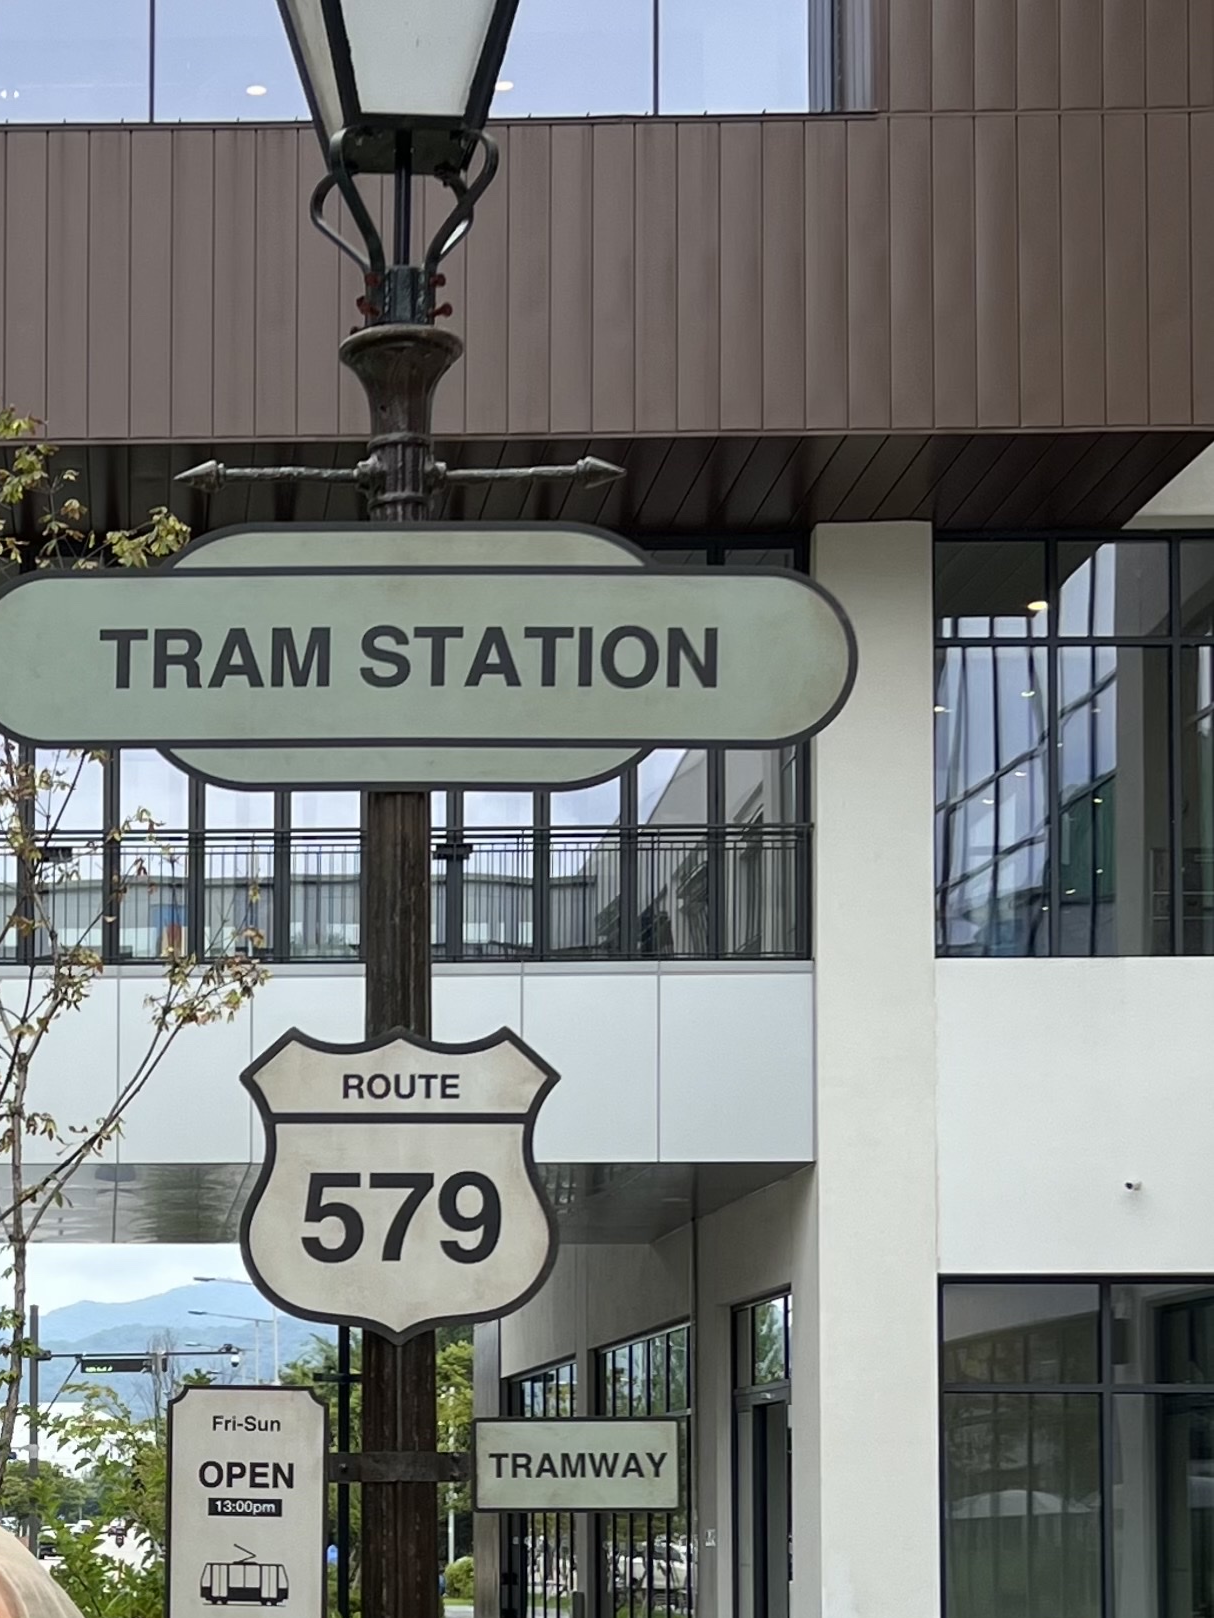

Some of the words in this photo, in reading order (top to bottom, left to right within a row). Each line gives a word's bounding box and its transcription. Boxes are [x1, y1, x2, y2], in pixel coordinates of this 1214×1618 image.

[99, 626, 331, 689] TRAM
[359, 624, 719, 690] STATION
[342, 1073, 460, 1100] ROUTE
[301, 1170, 502, 1265] 579
[212, 1415, 281, 1432] Fri-Sun
[198, 1460, 294, 1489] OPEN
[488, 1452, 668, 1479] TRAMWAY
[214, 1500, 276, 1516] 13:00pm
